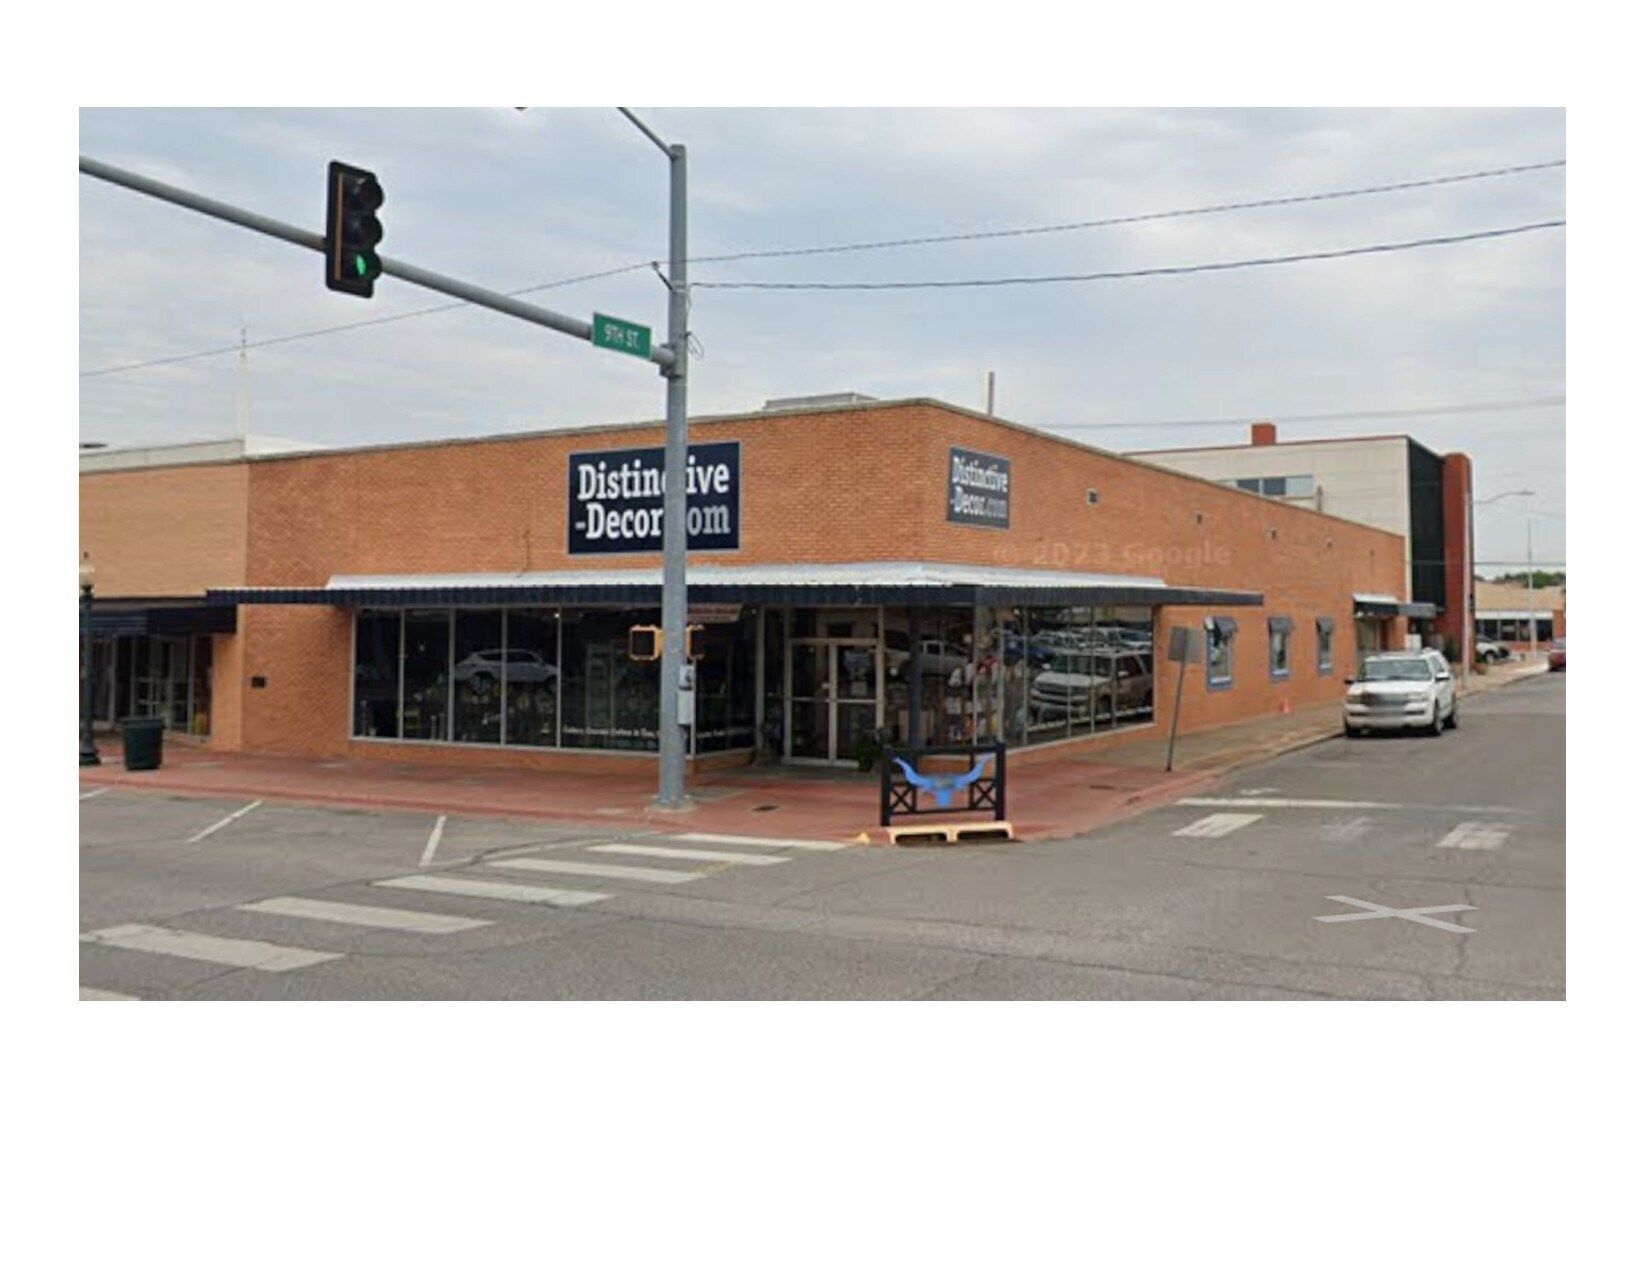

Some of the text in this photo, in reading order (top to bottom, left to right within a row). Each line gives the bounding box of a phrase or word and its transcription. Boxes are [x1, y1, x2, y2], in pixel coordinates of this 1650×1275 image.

[604, 324, 625, 345] 9TH
[577, 455, 730, 501] Distinive
[574, 502, 731, 540] -Decorom
